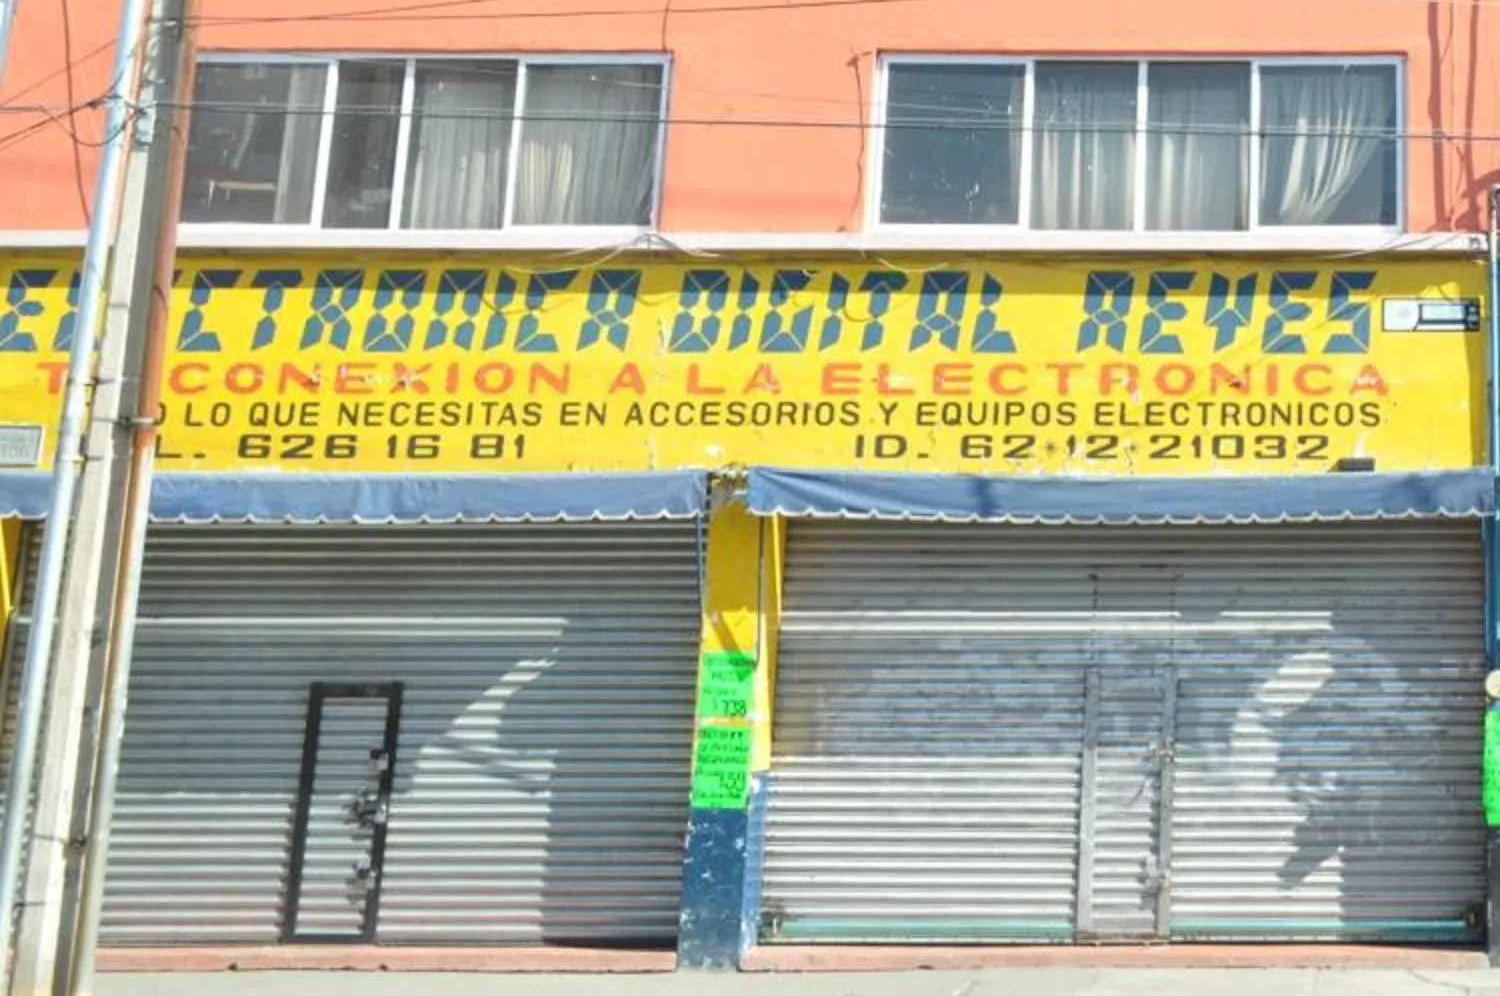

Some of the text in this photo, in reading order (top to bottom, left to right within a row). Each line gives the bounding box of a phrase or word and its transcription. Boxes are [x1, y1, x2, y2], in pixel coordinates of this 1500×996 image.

[0, 269, 1377, 353] ELCTRONICA DIGITAL REYES
[169, 362, 570, 395] CONEXION
[607, 362, 647, 395] A
[686, 362, 781, 395] LA
[821, 362, 1389, 397] ELECTRONICA
[184, 402, 231, 426] LO
[249, 402, 320, 427] QUE
[337, 402, 542, 427] NECESITAS
[560, 402, 607, 426] EN
[624, 401, 860, 427] ACCESORIOS
[879, 402, 898, 426] Y
[915, 402, 1077, 427] EQUIPOS
[1094, 402, 1381, 427] ELECTRONICOS
[237, 433, 358, 459] 626
[387, 433, 441, 459] 16
[470, 433, 524, 459] 81
